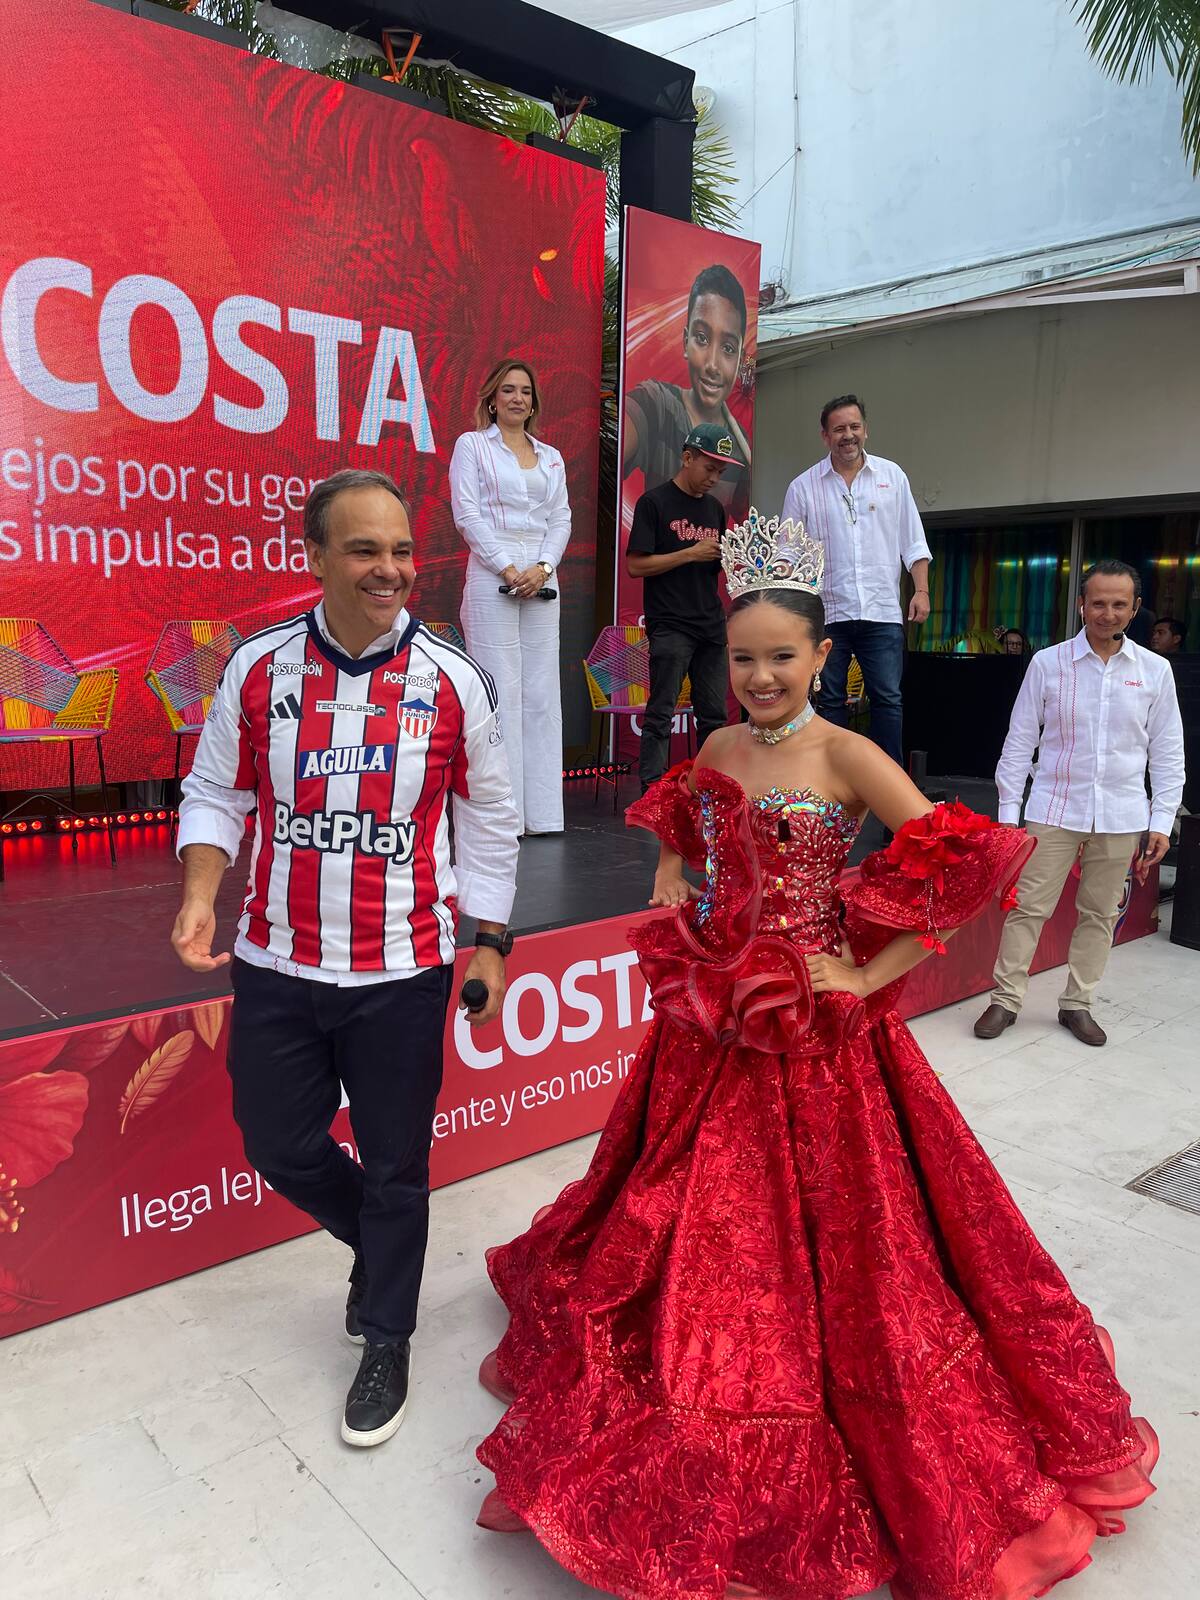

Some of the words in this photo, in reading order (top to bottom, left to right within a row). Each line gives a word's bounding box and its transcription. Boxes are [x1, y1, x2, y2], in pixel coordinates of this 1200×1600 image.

[0, 256, 437, 454] COSTA
[117, 459, 196, 512] por
[204, 468, 251, 508] su
[32, 509, 222, 579] impulsa
[230, 535, 253, 571] a
[403, 711, 431, 720] JUNIOR
[302, 745, 387, 778] AGUILA
[273, 803, 416, 862] BetPlay
[430, 1096, 497, 1148] ente
[500, 1089, 516, 1127] y
[521, 1075, 565, 1109] eso
[570, 1060, 614, 1095] nos
[120, 1184, 213, 1237] llega
